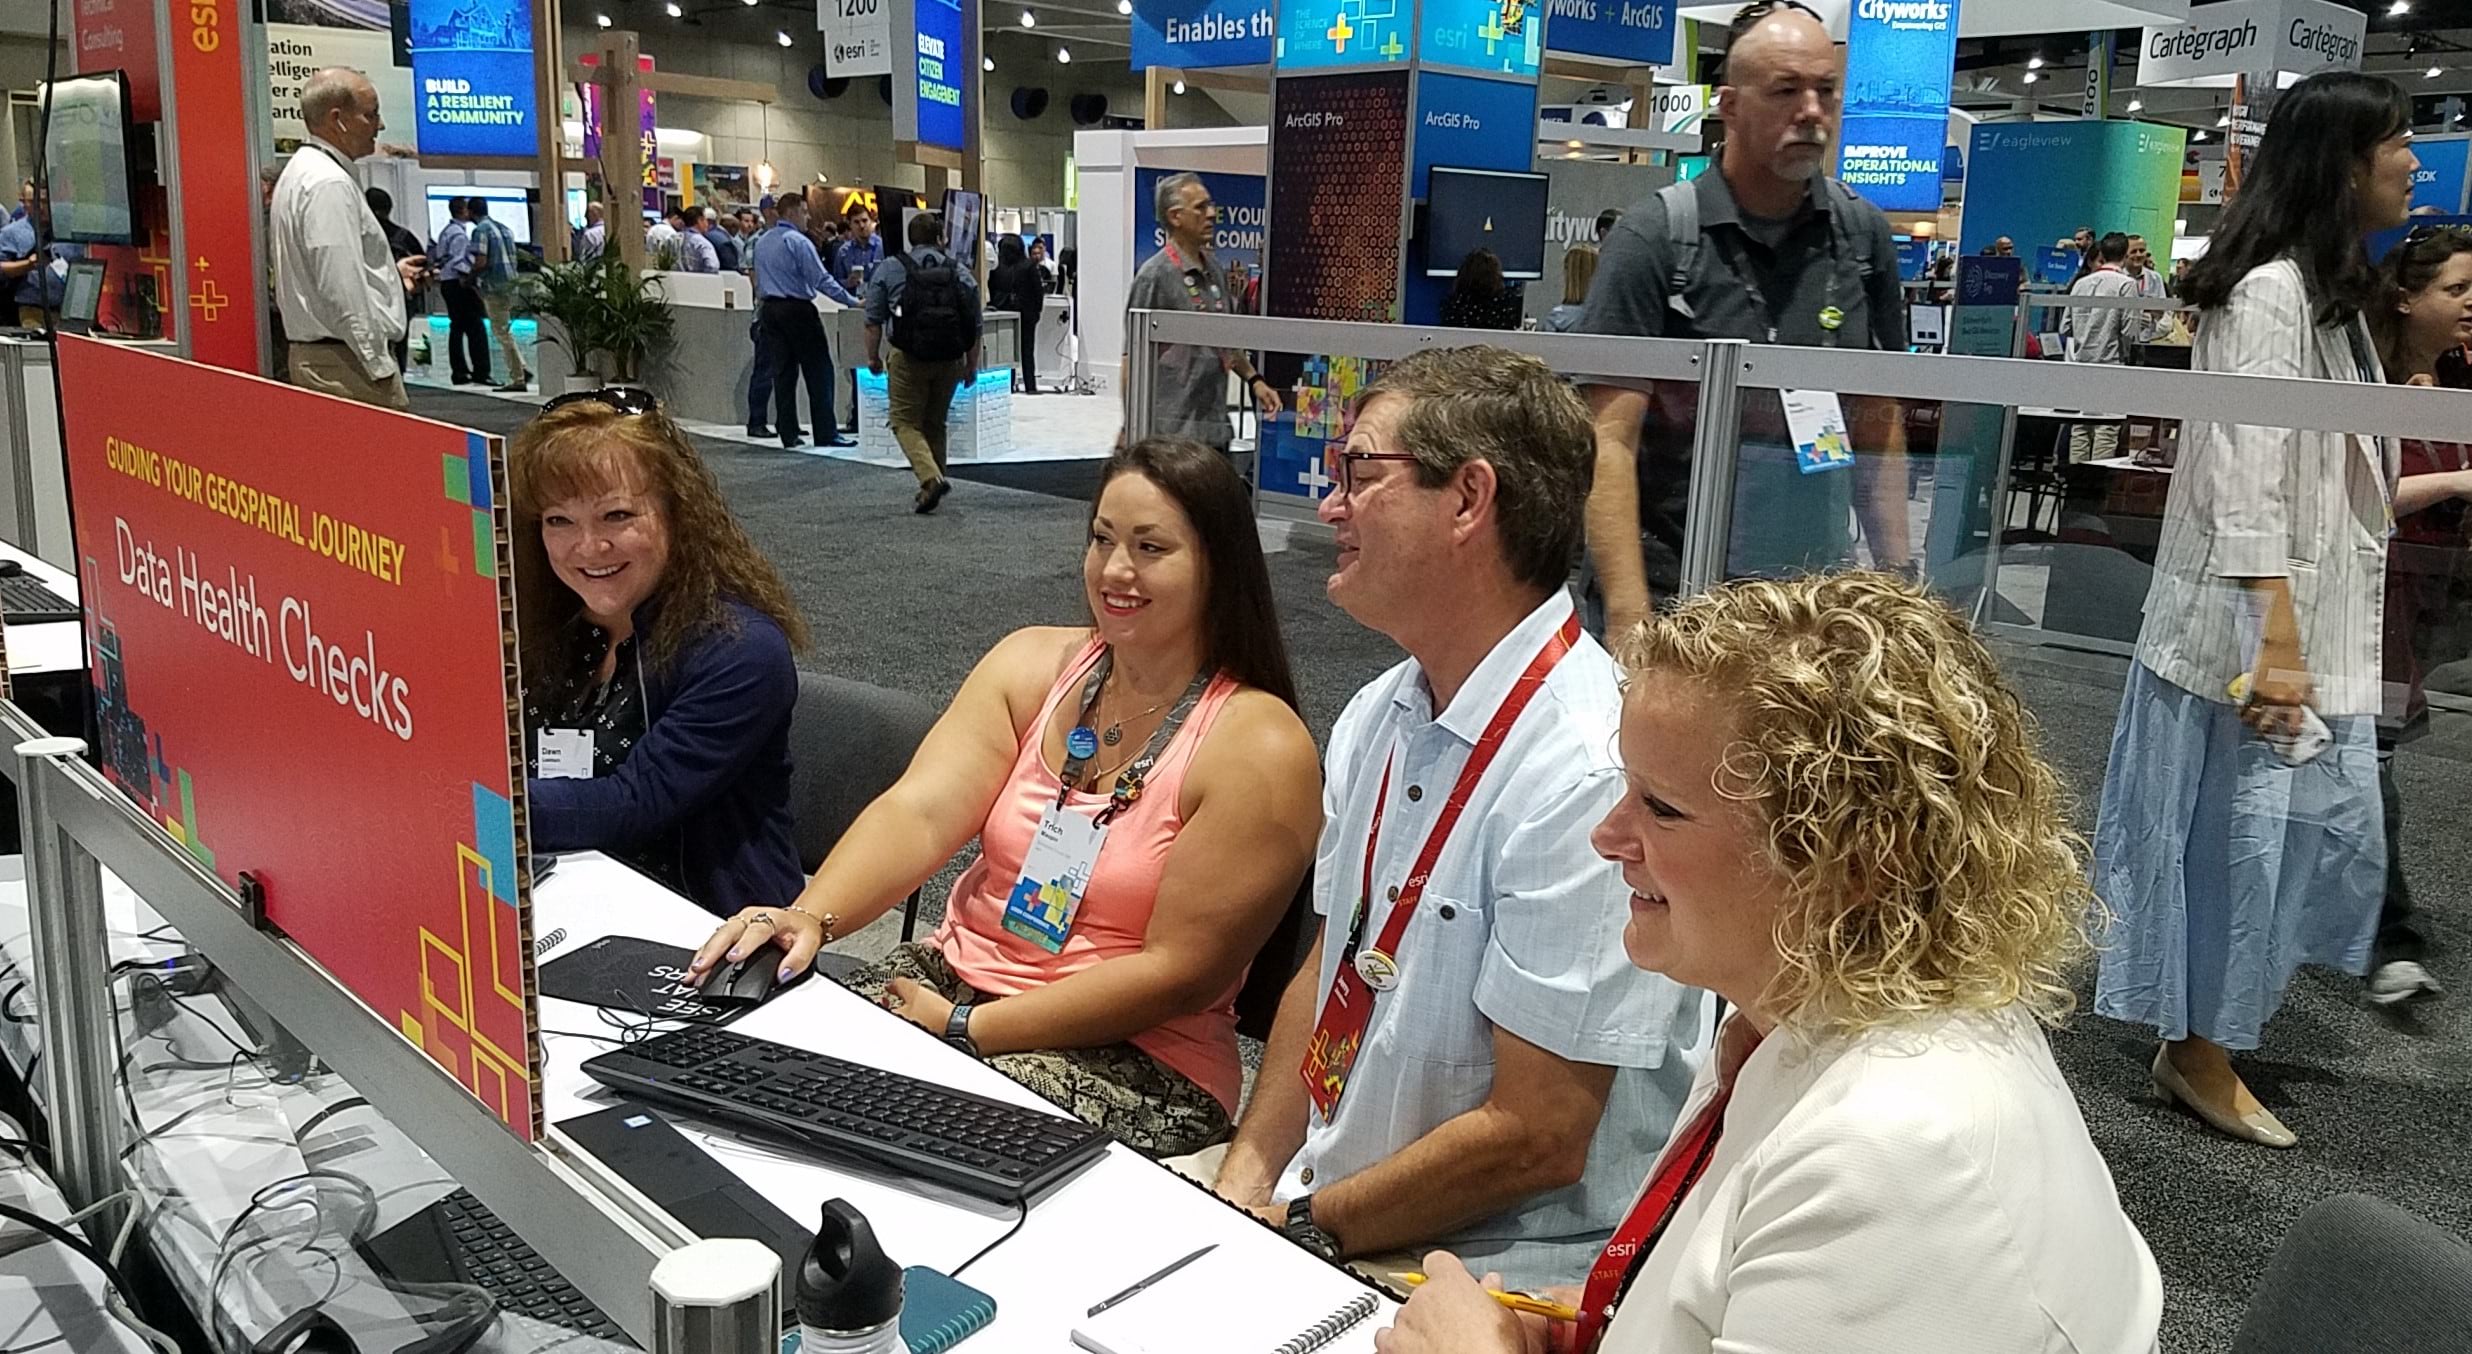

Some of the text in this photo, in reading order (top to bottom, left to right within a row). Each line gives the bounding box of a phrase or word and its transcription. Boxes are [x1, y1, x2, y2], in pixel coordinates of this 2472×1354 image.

[1621, 2, 1664, 30] ArcGIS
[1166, 12, 1246, 43] Enables
[1434, 24, 1468, 49] esri
[918, 31, 945, 60] ELEVATE
[2150, 18, 2257, 61] Cartegraph
[2289, 18, 2358, 62] Cartegraph
[846, 40, 866, 60] esri
[425, 78, 471, 94] BUILD
[427, 95, 513, 110] A RESILIENT
[1651, 94, 1692, 113] 1000
[427, 109, 525, 125] COMMUNITY
[1285, 112, 1344, 128] ArcGIS Pro
[1425, 110, 1481, 130] ArcGIS Pro
[2001, 133, 2073, 151] eagleview
[1844, 145, 1908, 159] IMPROVE
[1842, 158, 1939, 173] OPERATIONAL
[1841, 171, 1906, 185] INSIGHTS
[2415, 171, 2438, 183] SDK
[106, 435, 407, 586] GUIDING YOUR GEOSPATIAL JOURNEY
[115, 516, 413, 741] Data Health Checks
[1044, 819, 1064, 837] Trich
[1408, 869, 1430, 888] esri
[1607, 1238, 1636, 1257] esri
